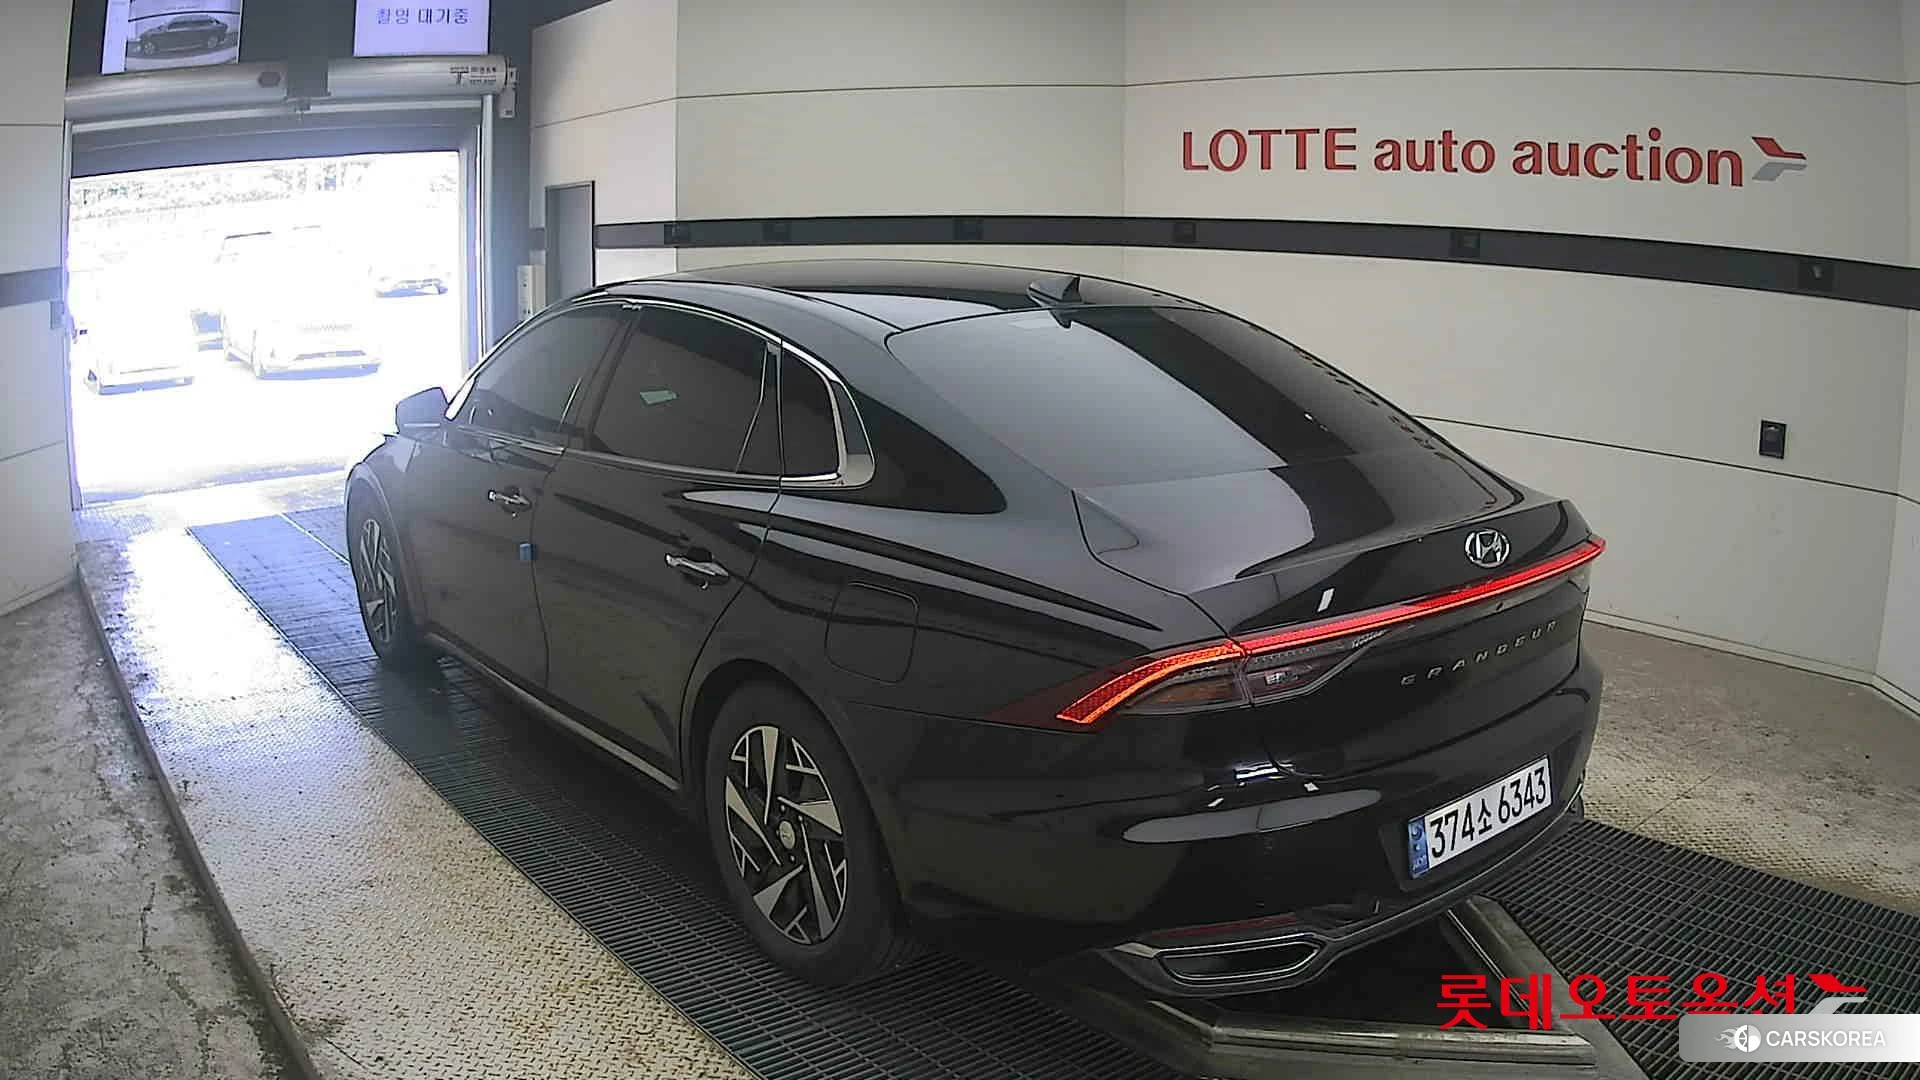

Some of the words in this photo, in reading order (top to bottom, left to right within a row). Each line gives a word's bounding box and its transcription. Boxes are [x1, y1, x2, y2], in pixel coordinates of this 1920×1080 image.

[418, 8, 470, 25] 대기중
[1182, 128, 1357, 171] LOTTE
[1374, 130, 1496, 173] auto
[1512, 127, 1744, 186] auction
[1400, 620, 1557, 687] GRANDEUR
[1429, 798, 1493, 858] 374소
[1498, 766, 1547, 824] 6343
